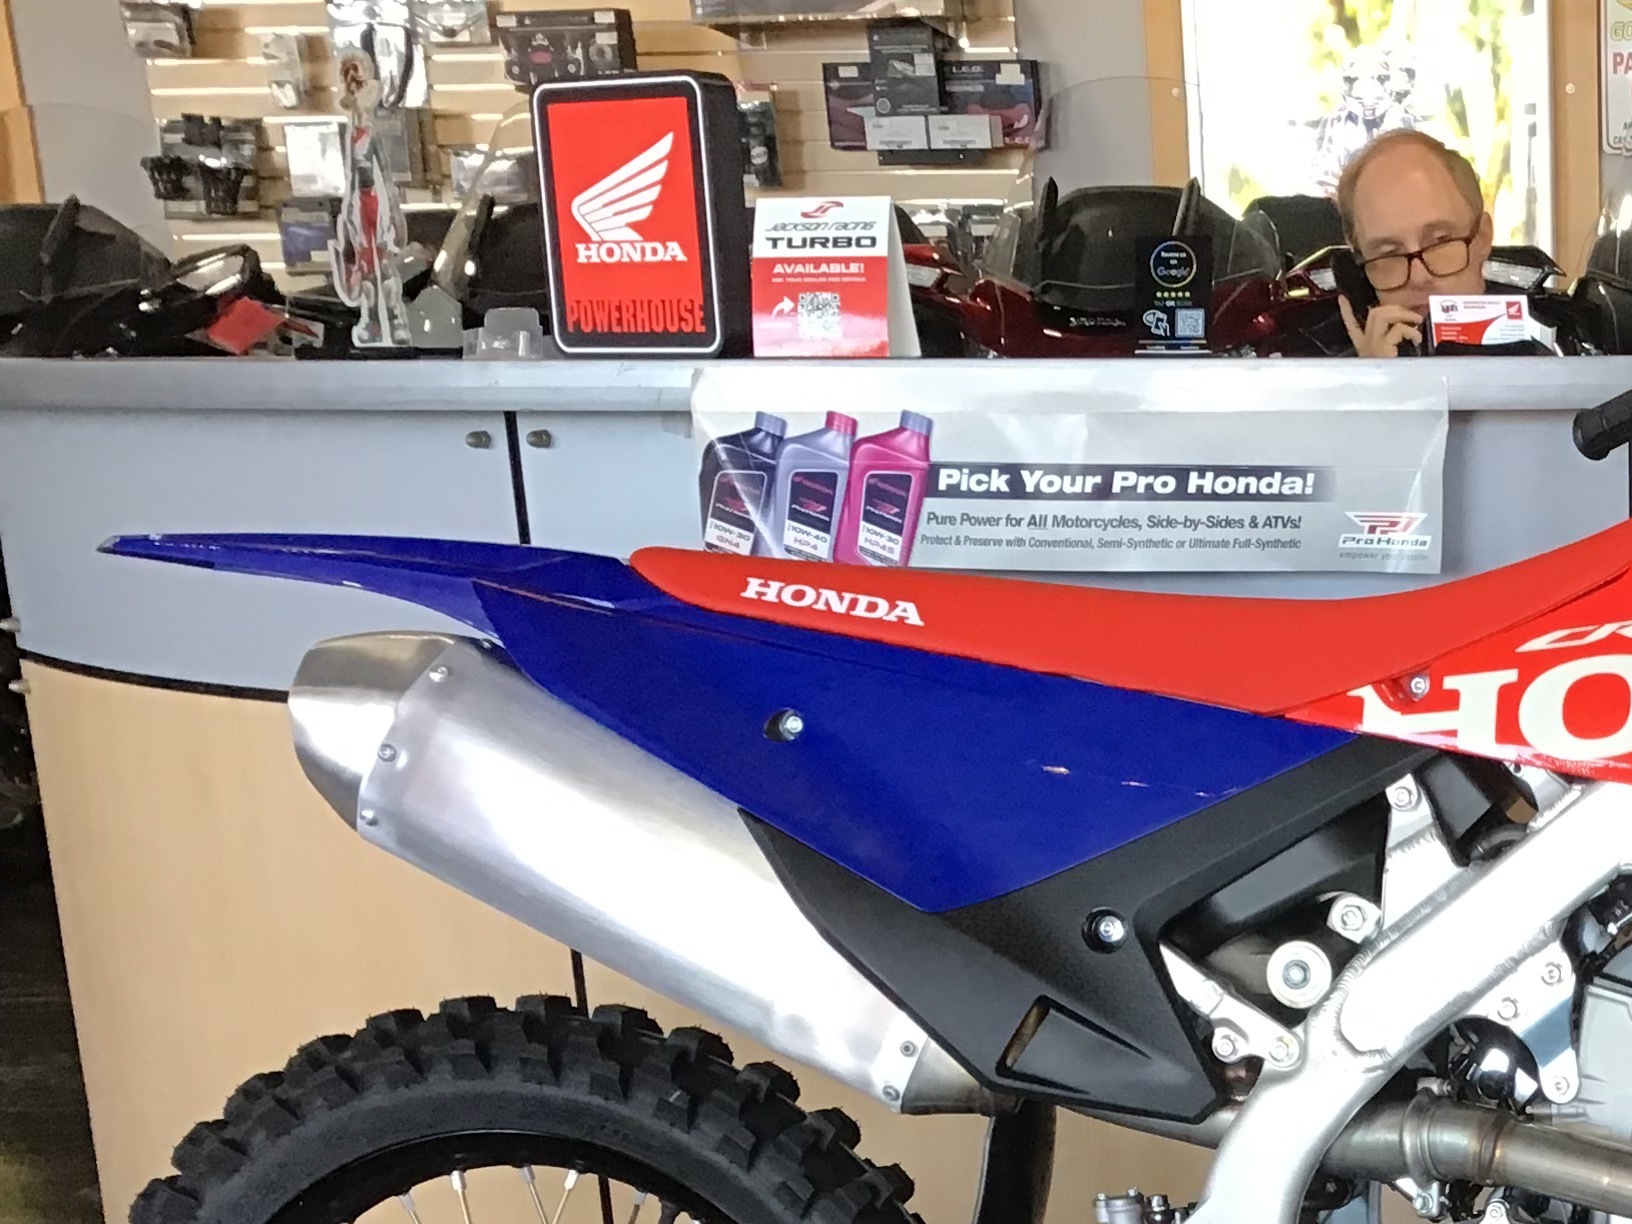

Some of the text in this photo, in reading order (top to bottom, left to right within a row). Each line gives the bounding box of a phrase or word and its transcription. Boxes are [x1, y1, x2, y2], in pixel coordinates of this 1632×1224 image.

[575, 240, 689, 263] HONDA
[765, 236, 878, 250] TURBO
[773, 263, 865, 274] AVAILABLE!
[567, 299, 707, 333] POWERHOUSE
[938, 468, 1315, 495] Pick Your Pro Honda!
[926, 511, 1302, 531] Pure Power for All Motorcycles, Side-by-Sides & ATVs!
[791, 524, 828, 544] 10W-40
[793, 537, 818, 551] HP4
[865, 525, 900, 545] 10W-30
[920, 534, 1301, 551] Protect & Preserve with Conventional, Semi-Synthetic or Ultimate Full-Synthetic
[740, 577, 925, 627] HONDA
